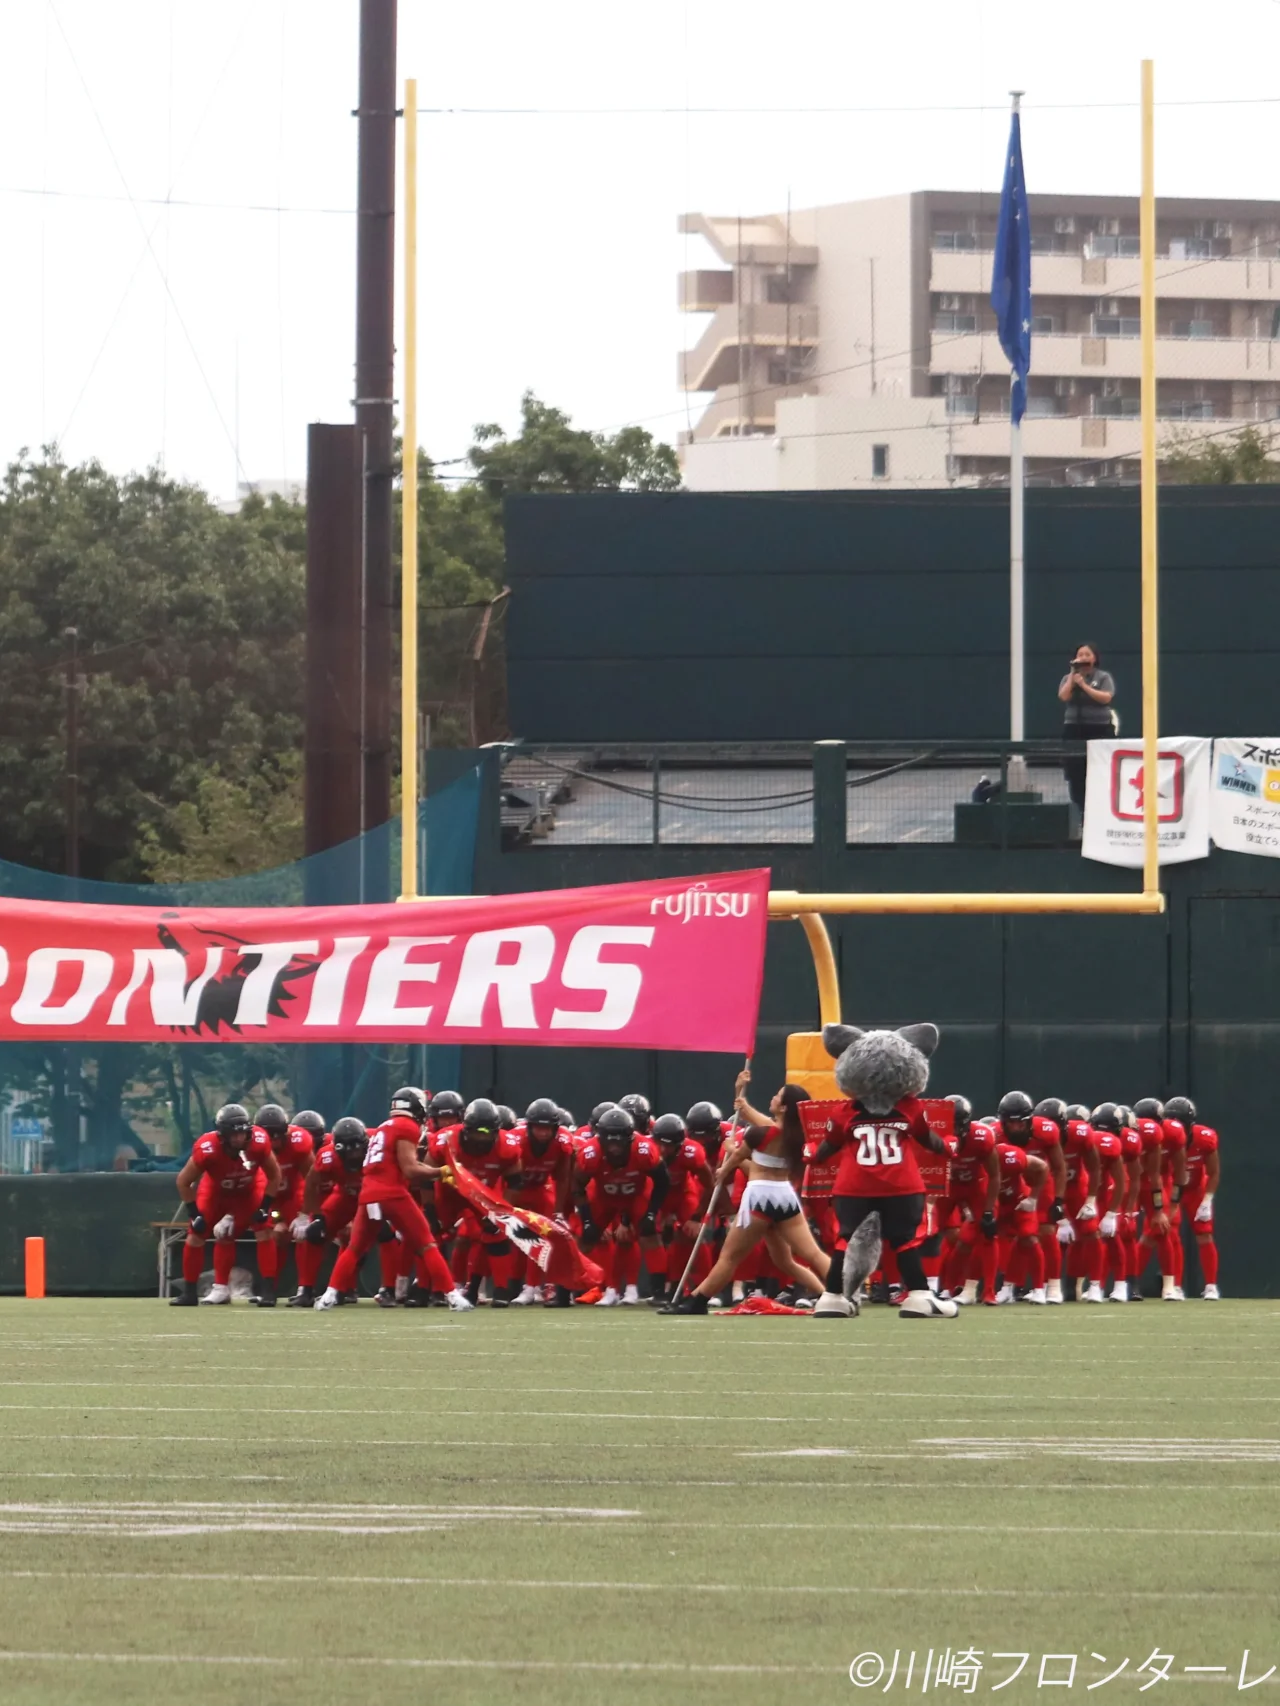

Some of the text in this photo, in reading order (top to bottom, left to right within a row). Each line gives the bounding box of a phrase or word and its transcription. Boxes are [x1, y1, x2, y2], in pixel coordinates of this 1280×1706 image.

[1241, 742, 1280, 767] スポ
[1221, 775, 1257, 793] WINNER
[650, 882, 750, 924] FUJITSU
[852, 1126, 903, 1166] 00
